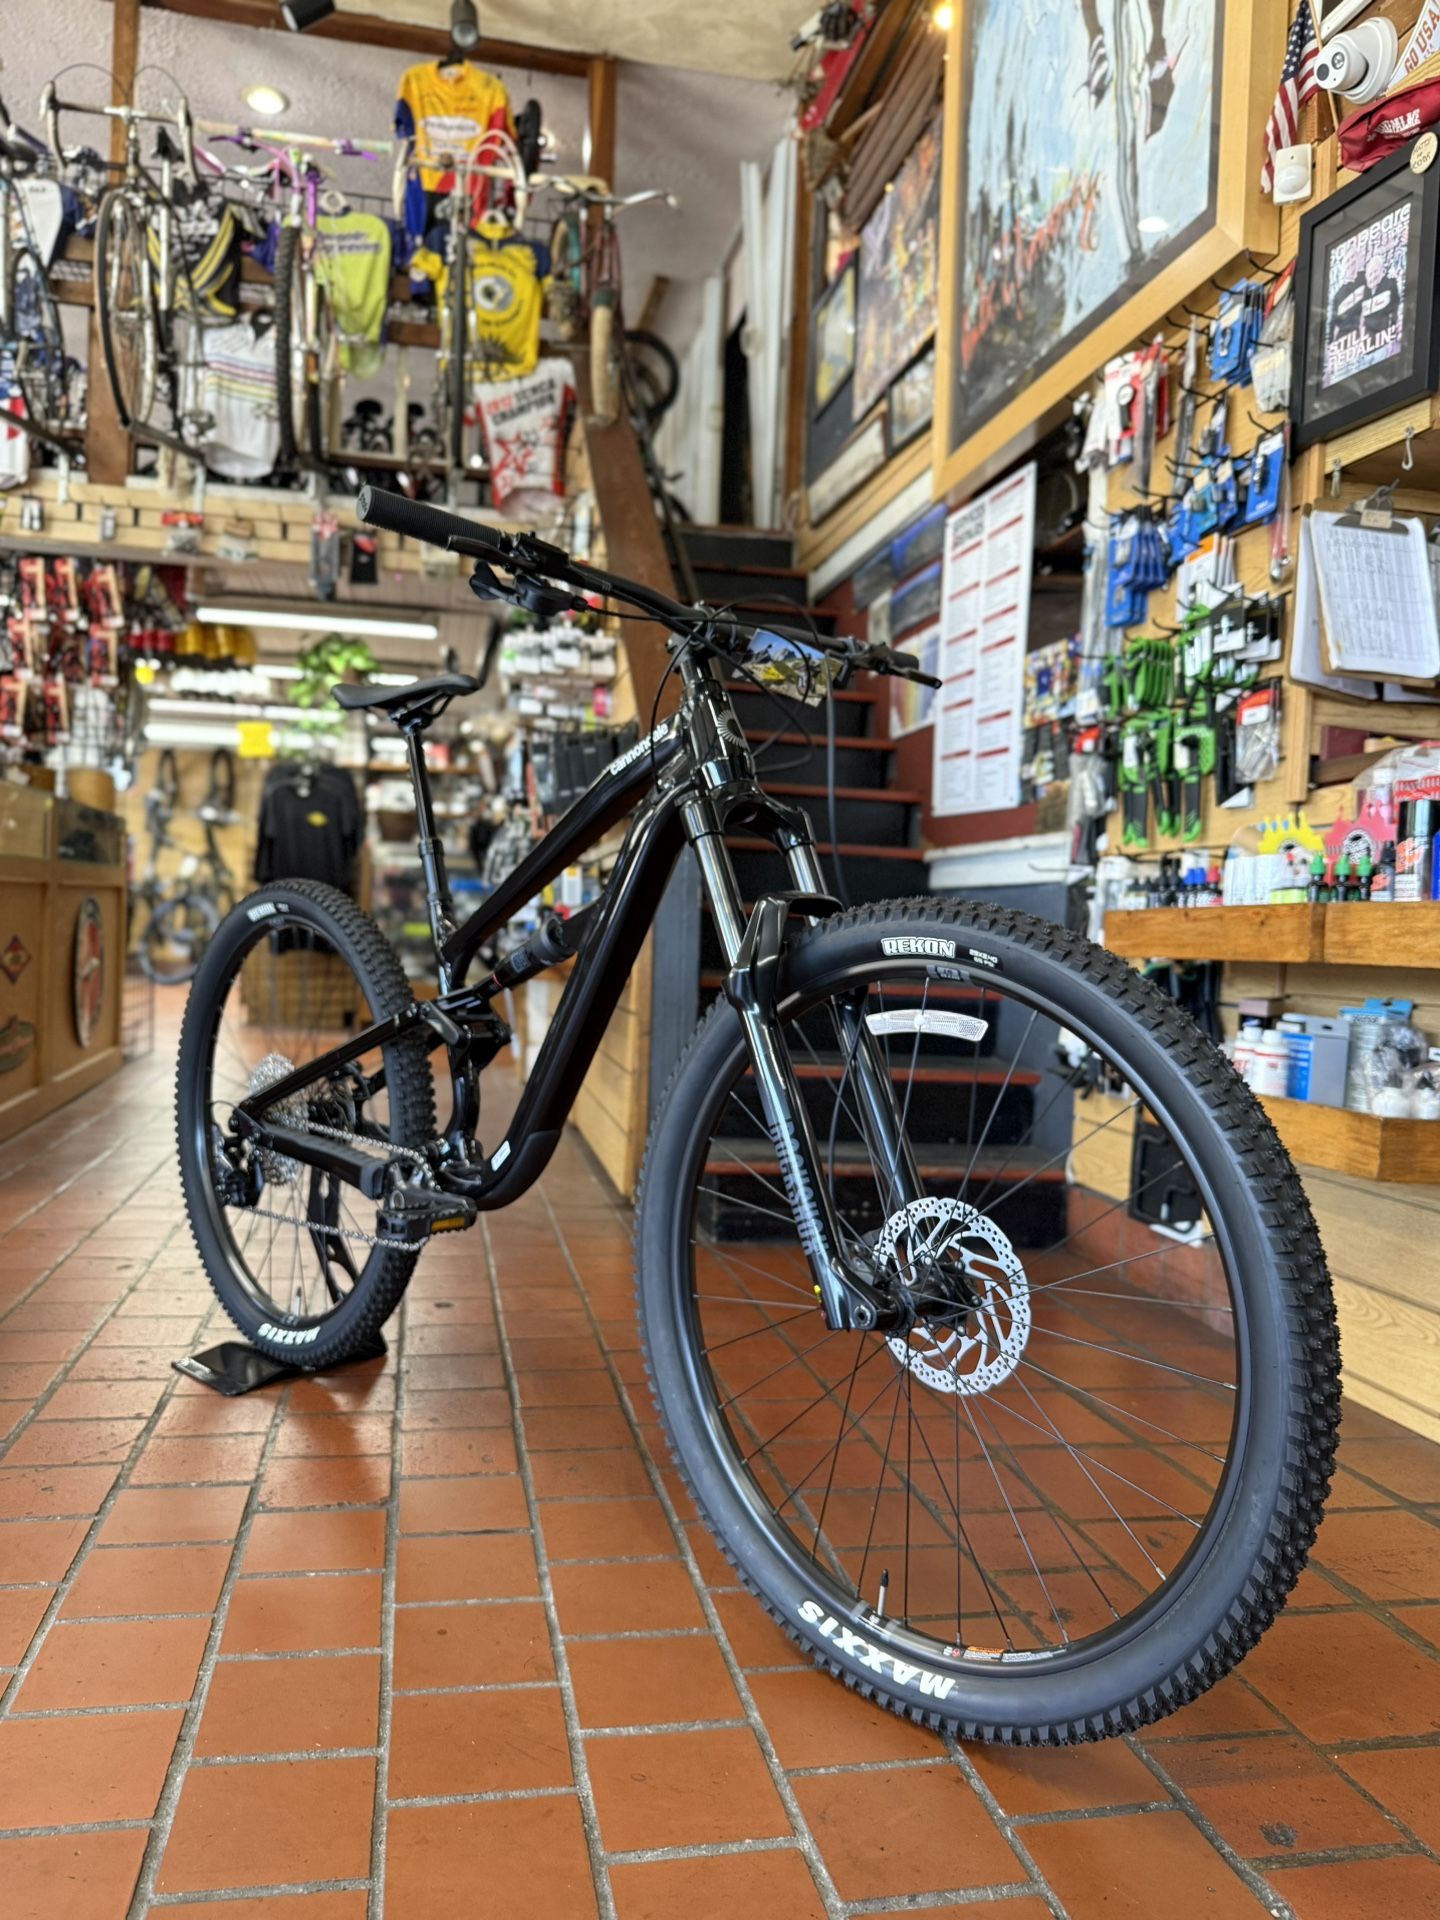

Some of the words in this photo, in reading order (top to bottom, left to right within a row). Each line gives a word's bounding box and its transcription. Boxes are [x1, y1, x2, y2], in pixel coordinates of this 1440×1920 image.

[1404, 48, 1419, 74] GO
[1327, 325, 1396, 376] PEDALIN'
[1328, 325, 1370, 355] STILL
[881, 936, 956, 958] REKON
[769, 1118, 830, 1258] ROCKSHOX
[257, 1323, 320, 1346] MAXXIS
[798, 1600, 955, 1700] MAXXIS
